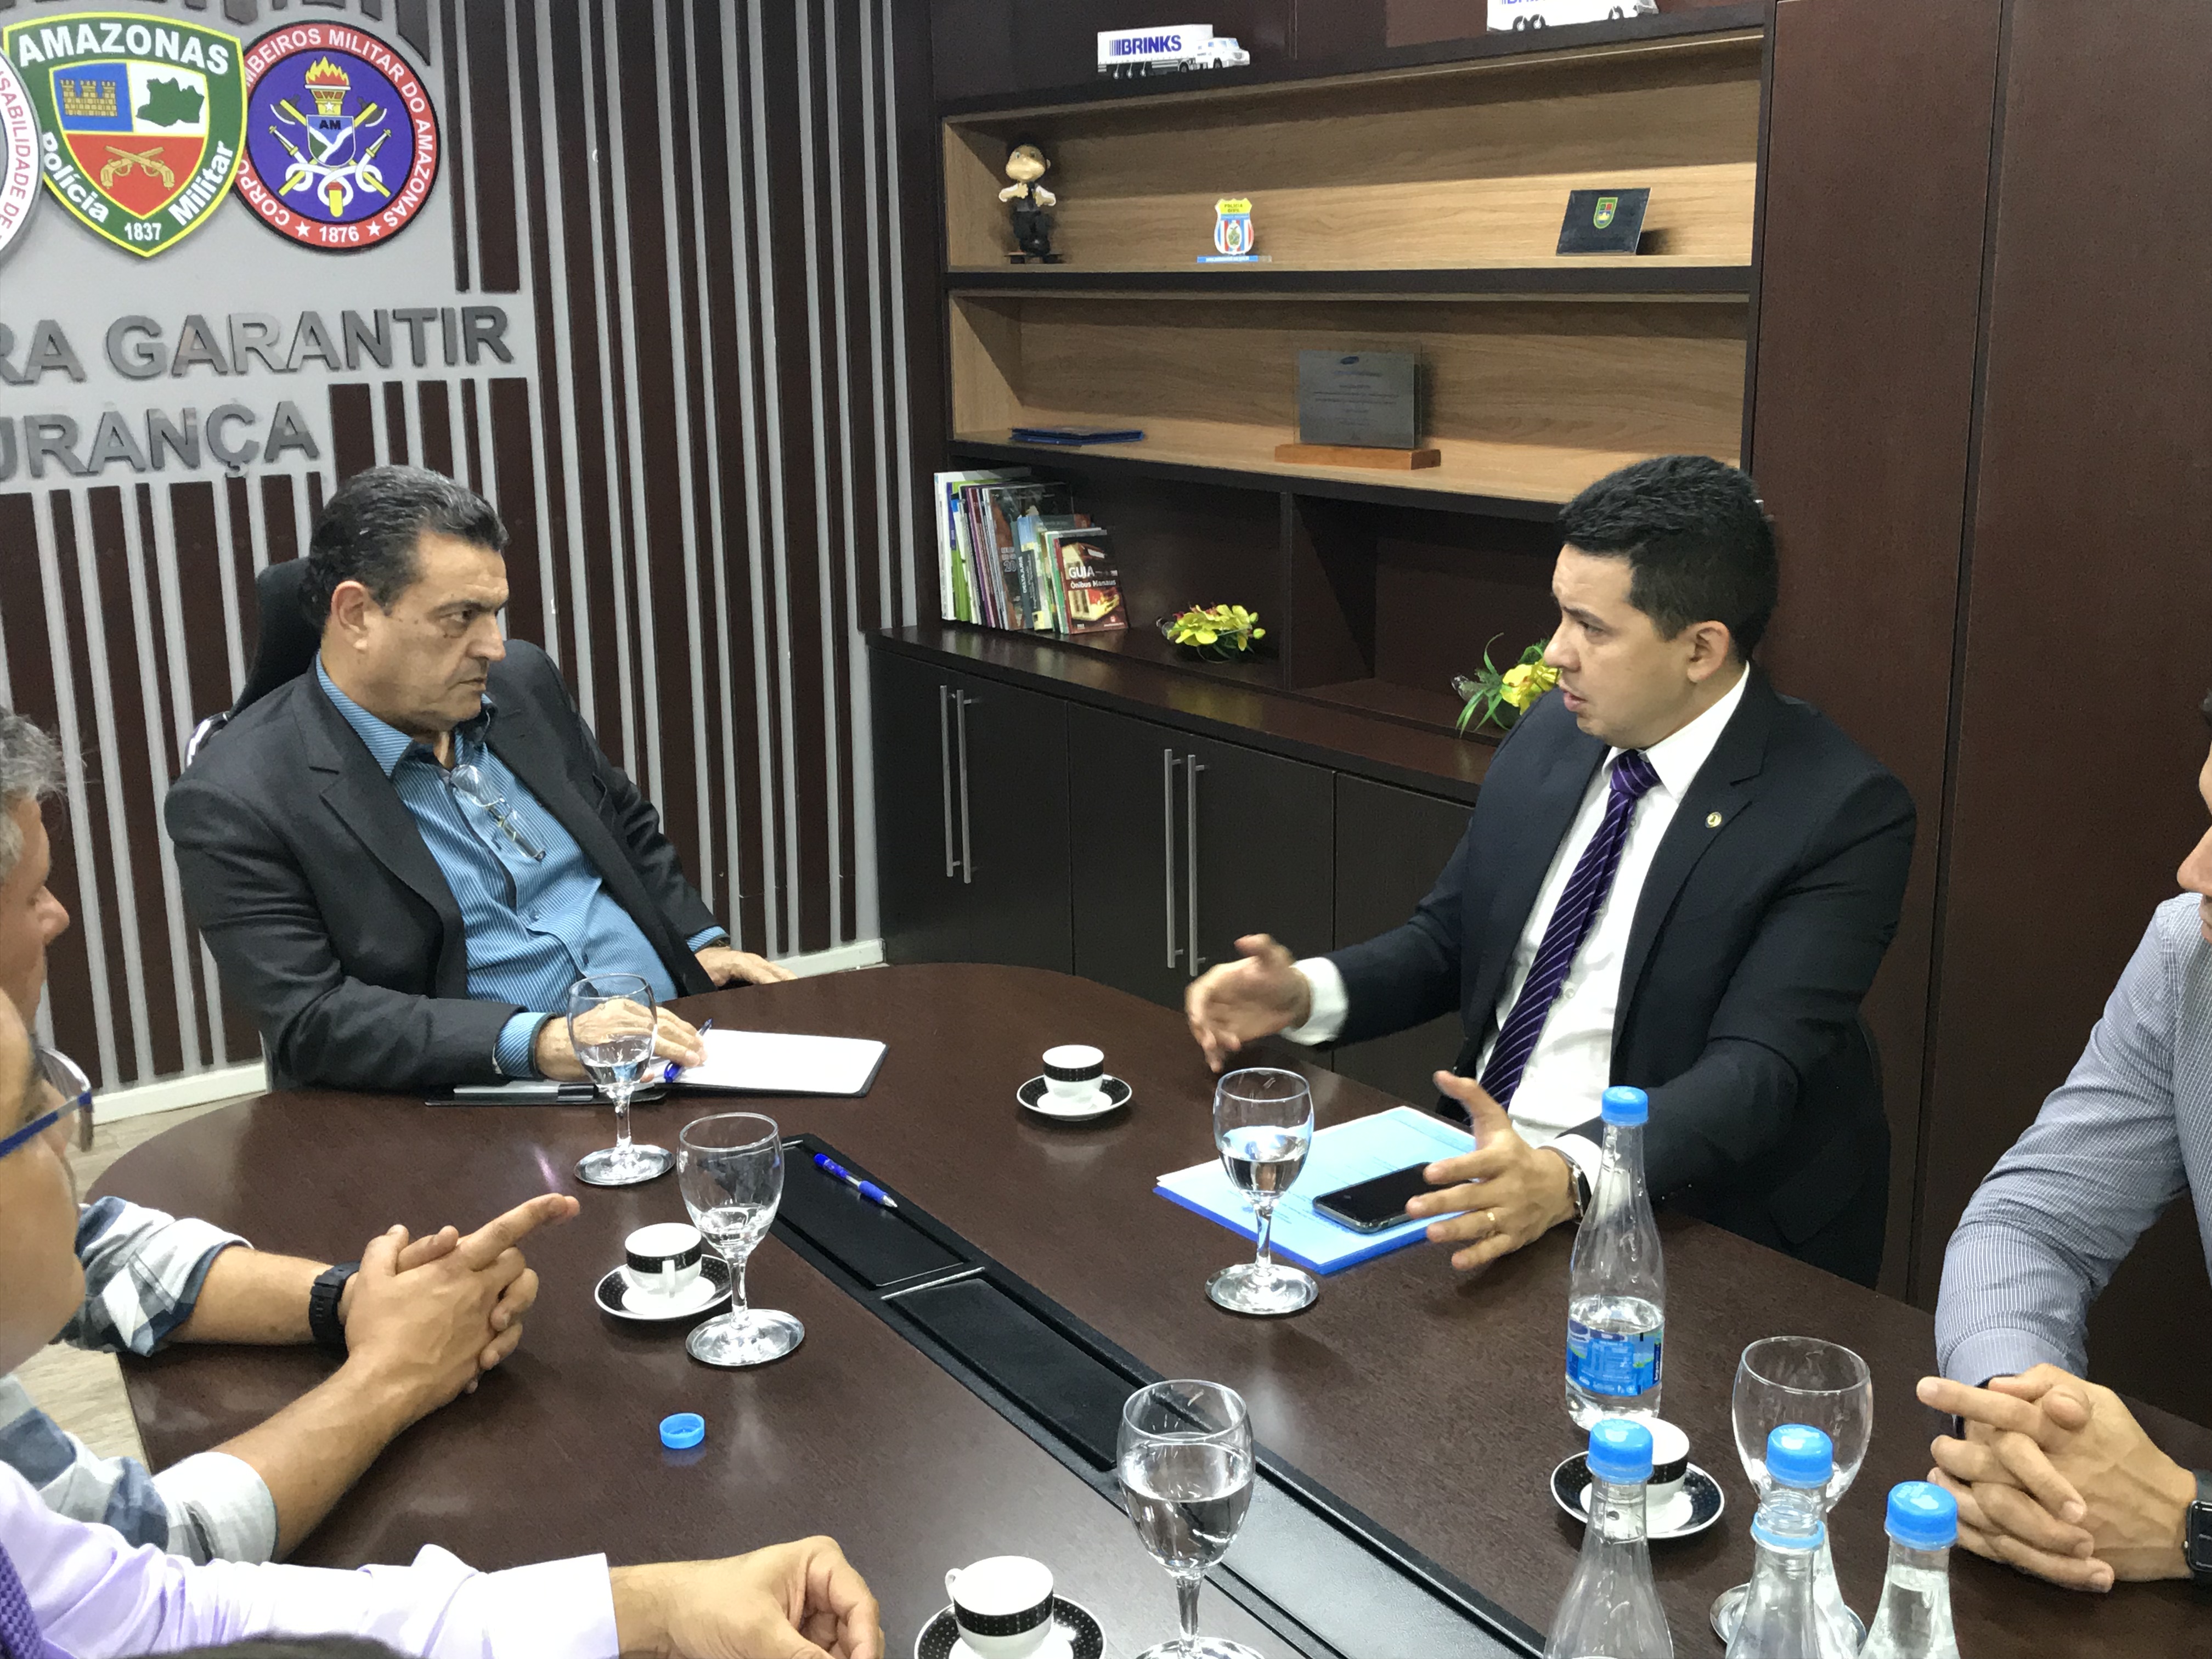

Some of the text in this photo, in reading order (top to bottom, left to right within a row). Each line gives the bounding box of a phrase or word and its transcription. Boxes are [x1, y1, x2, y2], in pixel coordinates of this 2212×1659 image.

[18, 22, 229, 75] AMAZONAS
[329, 29, 405, 82] MILITAR
[1121, 35, 1182, 55] BRINKS
[401, 81, 425, 113] DO
[0, 70, 31, 200] SABILIDADE
[319, 120, 341, 130] AM
[42, 131, 109, 223] Polícia
[168, 140, 234, 226] Militar
[383, 119, 436, 227] AMAZONAS
[125, 223, 162, 241] 1837
[319, 225, 359, 242] 1876
[106, 305, 514, 379] GARANTIR
[1069, 566, 1095, 578] GUIA
